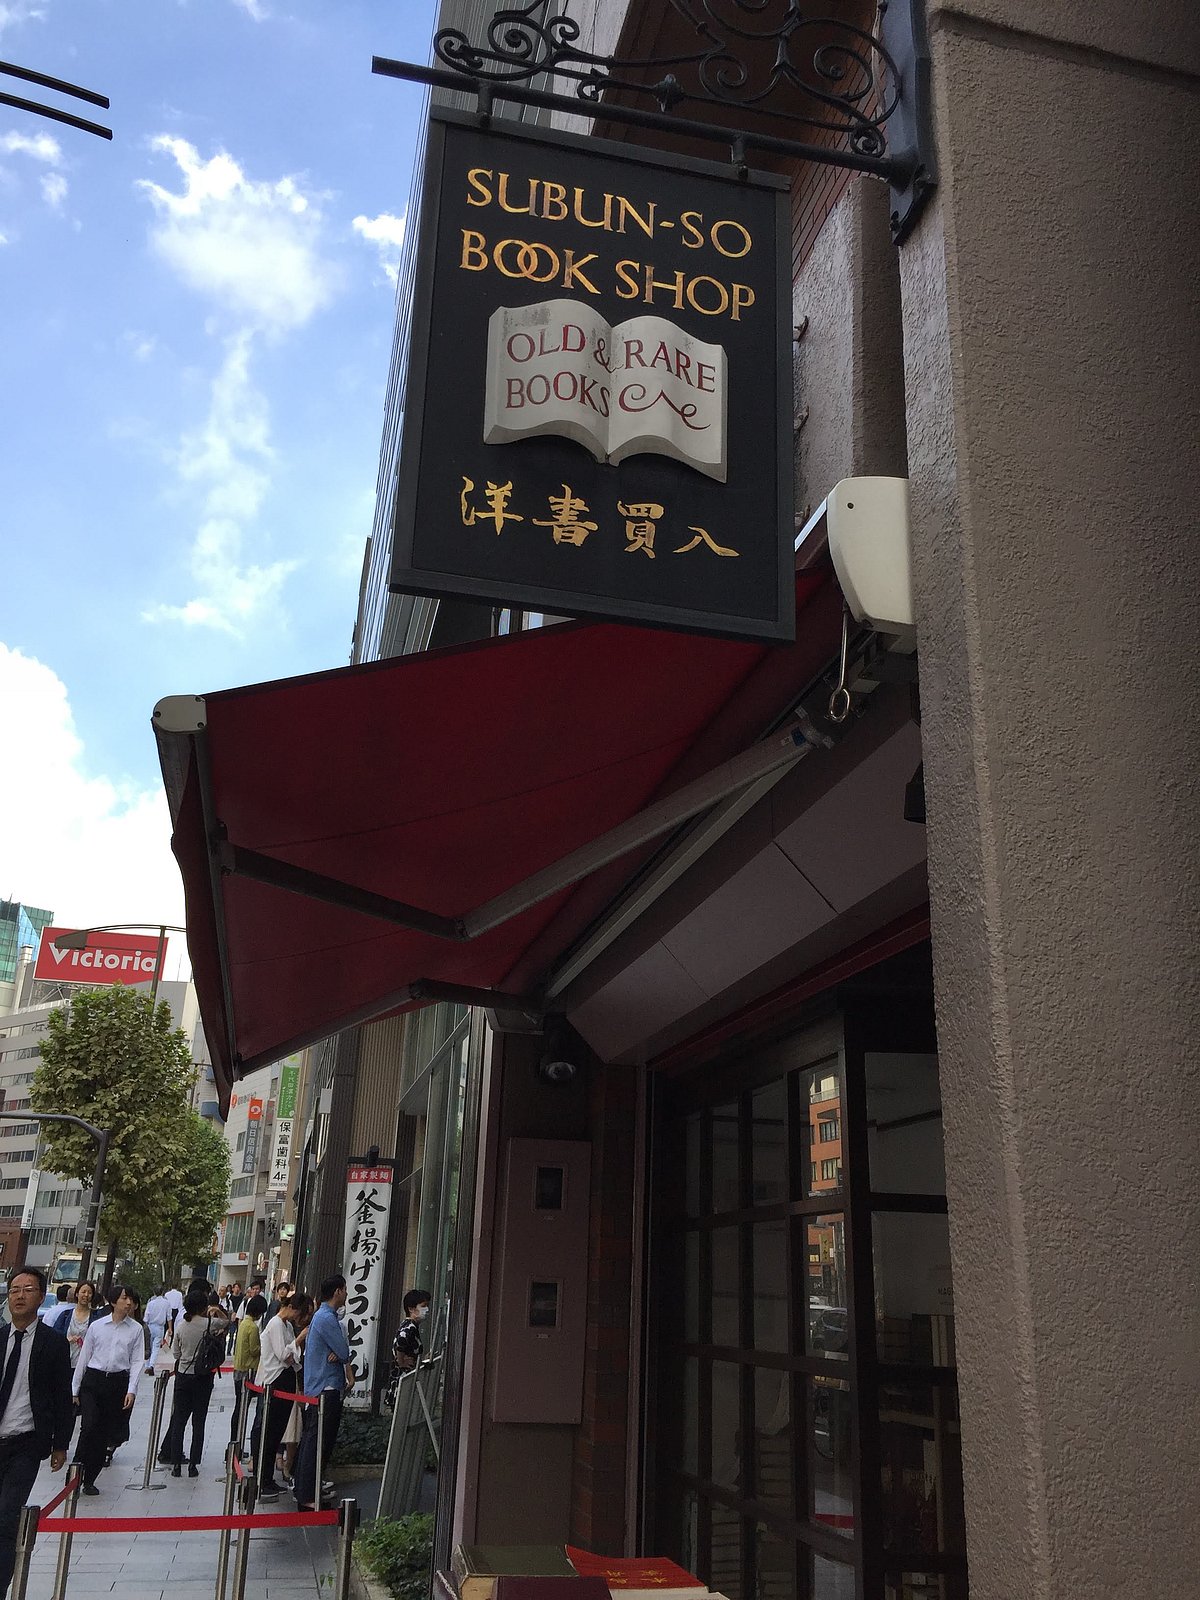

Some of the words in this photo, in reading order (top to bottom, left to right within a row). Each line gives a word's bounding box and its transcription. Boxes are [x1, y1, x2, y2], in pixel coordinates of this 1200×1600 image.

[466, 168, 753, 258] SUBUN-SO
[459, 228, 601, 295] BOOK
[615, 259, 756, 322] SHOP
[506, 324, 587, 363] OLD
[593, 337, 623, 373] &
[624, 339, 716, 393] RARE
[505, 371, 610, 418] BOOKS
[460, 476, 740, 559] 洋書買入
[48, 942, 158, 972] Victoria
[272, 1171, 287, 1181] 4F
[351, 1170, 389, 1180] 自家製麺
[346, 1188, 387, 1382] 釜揚げうどん
